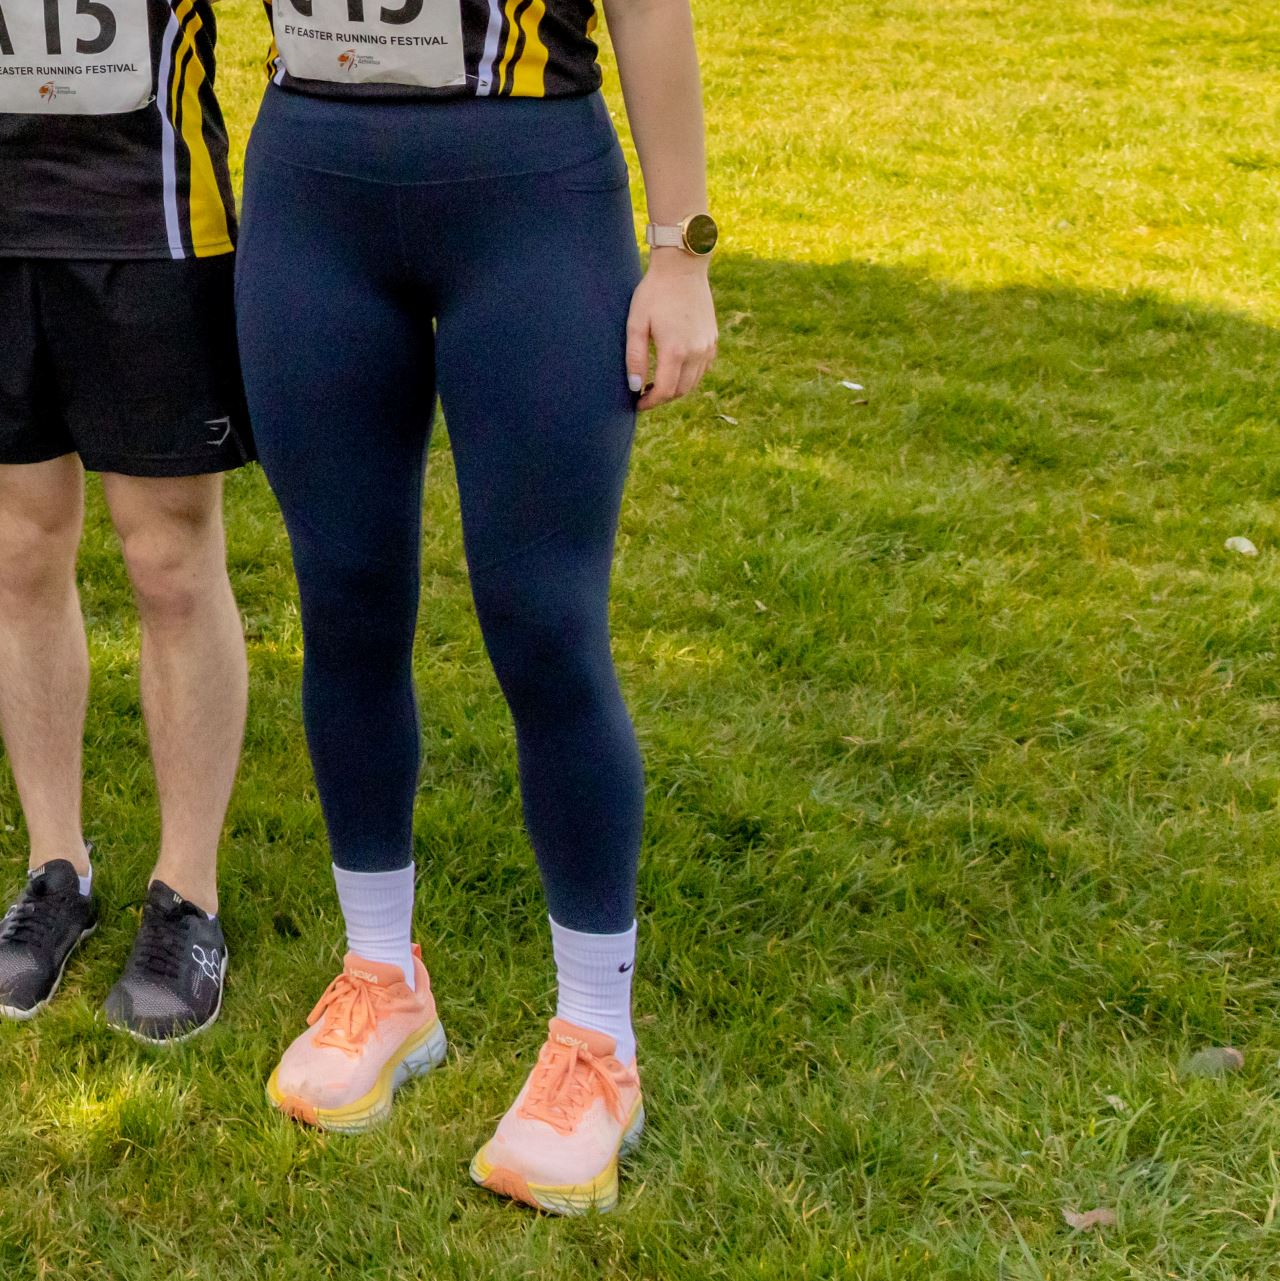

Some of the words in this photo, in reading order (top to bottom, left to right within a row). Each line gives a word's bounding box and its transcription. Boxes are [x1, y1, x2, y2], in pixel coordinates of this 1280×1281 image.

[284, 24, 296, 36] EY
[297, 27, 333, 41] EASTER
[336, 32, 387, 45] RUNNING
[390, 35, 448, 46] FESTIVAL
[36, 65, 82, 75] RUNNING
[85, 63, 138, 74] FESTIVAL
